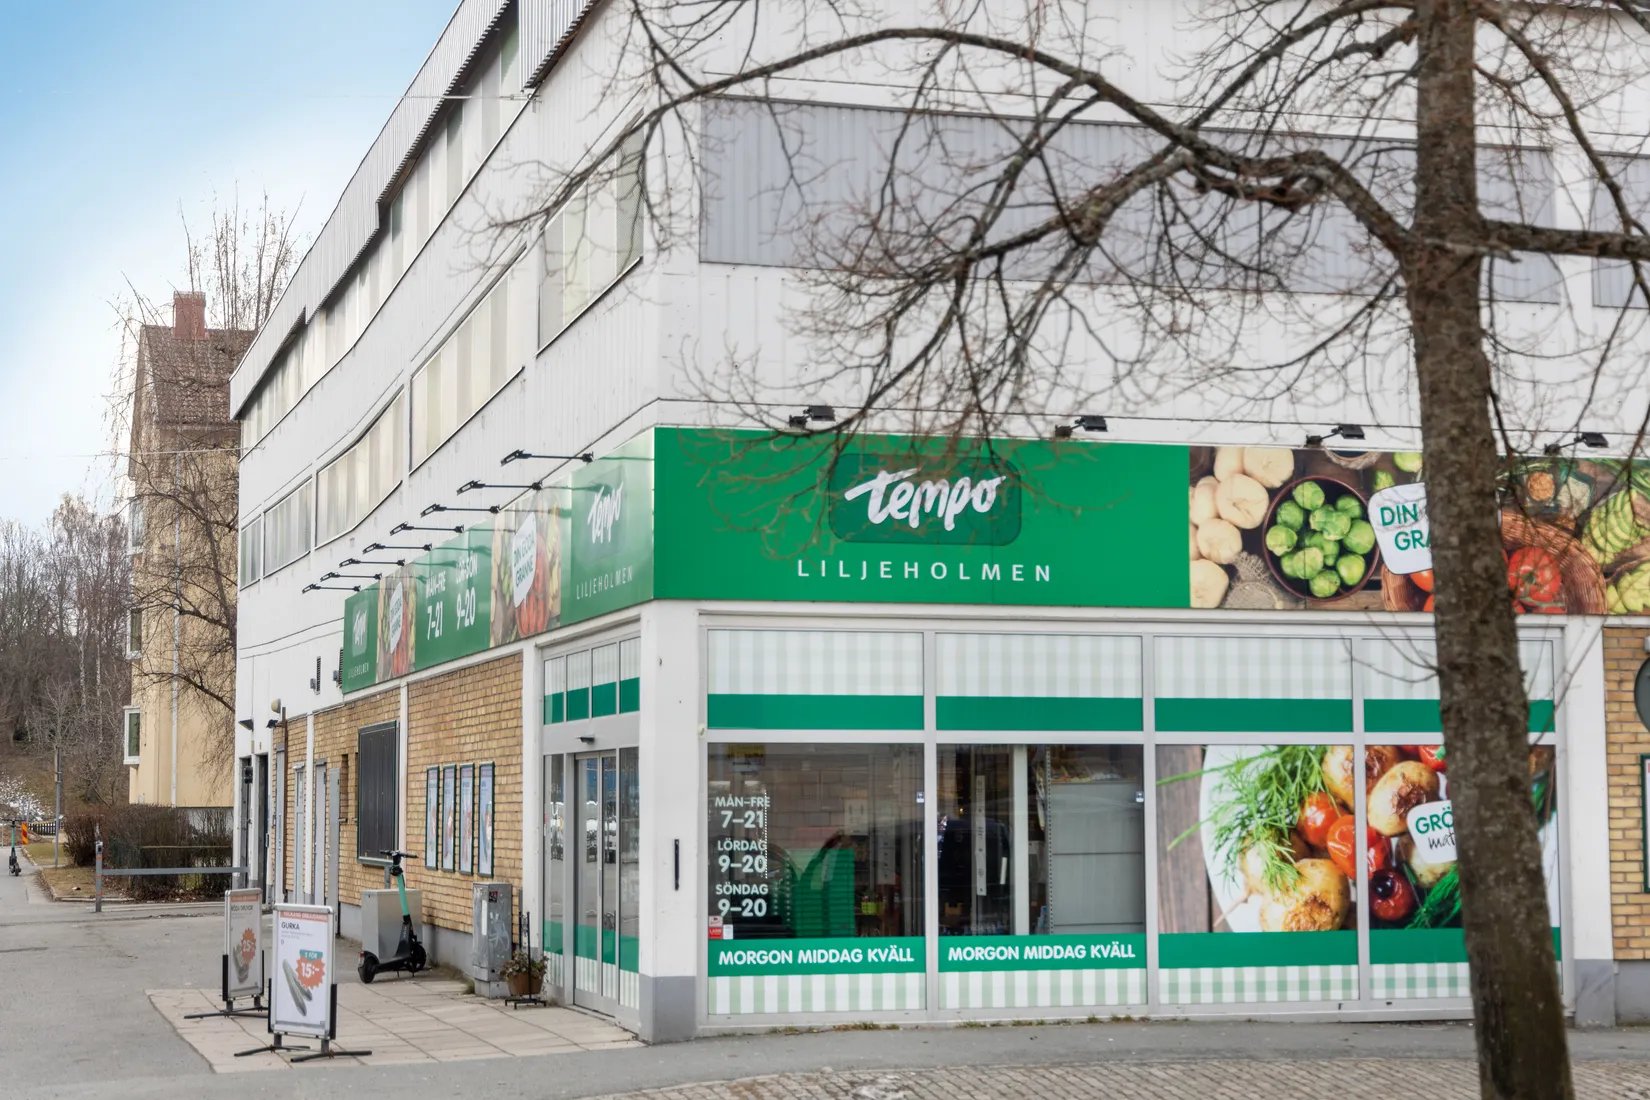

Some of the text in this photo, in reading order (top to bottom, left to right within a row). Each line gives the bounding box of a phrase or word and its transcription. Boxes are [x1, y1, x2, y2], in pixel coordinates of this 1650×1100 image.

[1380, 503, 1418, 526] DIN
[797, 559, 1051, 582] LILJEHOLMEN
[576, 565, 633, 600] LILJEHOLMEN
[457, 586, 476, 631] 9-20
[427, 600, 443, 641] 7-21
[714, 793, 771, 807] MÅN-FRE
[720, 810, 764, 829] 7-21
[717, 838, 767, 851] LÖRDAG
[718, 854, 767, 873] 9-20
[715, 881, 769, 895] SÖNDAG
[718, 898, 767, 917] 9-20
[281, 921, 300, 930] GURKA
[718, 944, 915, 966] MORGON MIDDAG KVÄLL
[948, 941, 1136, 961] MORGON MIDDAG KVÄLL
